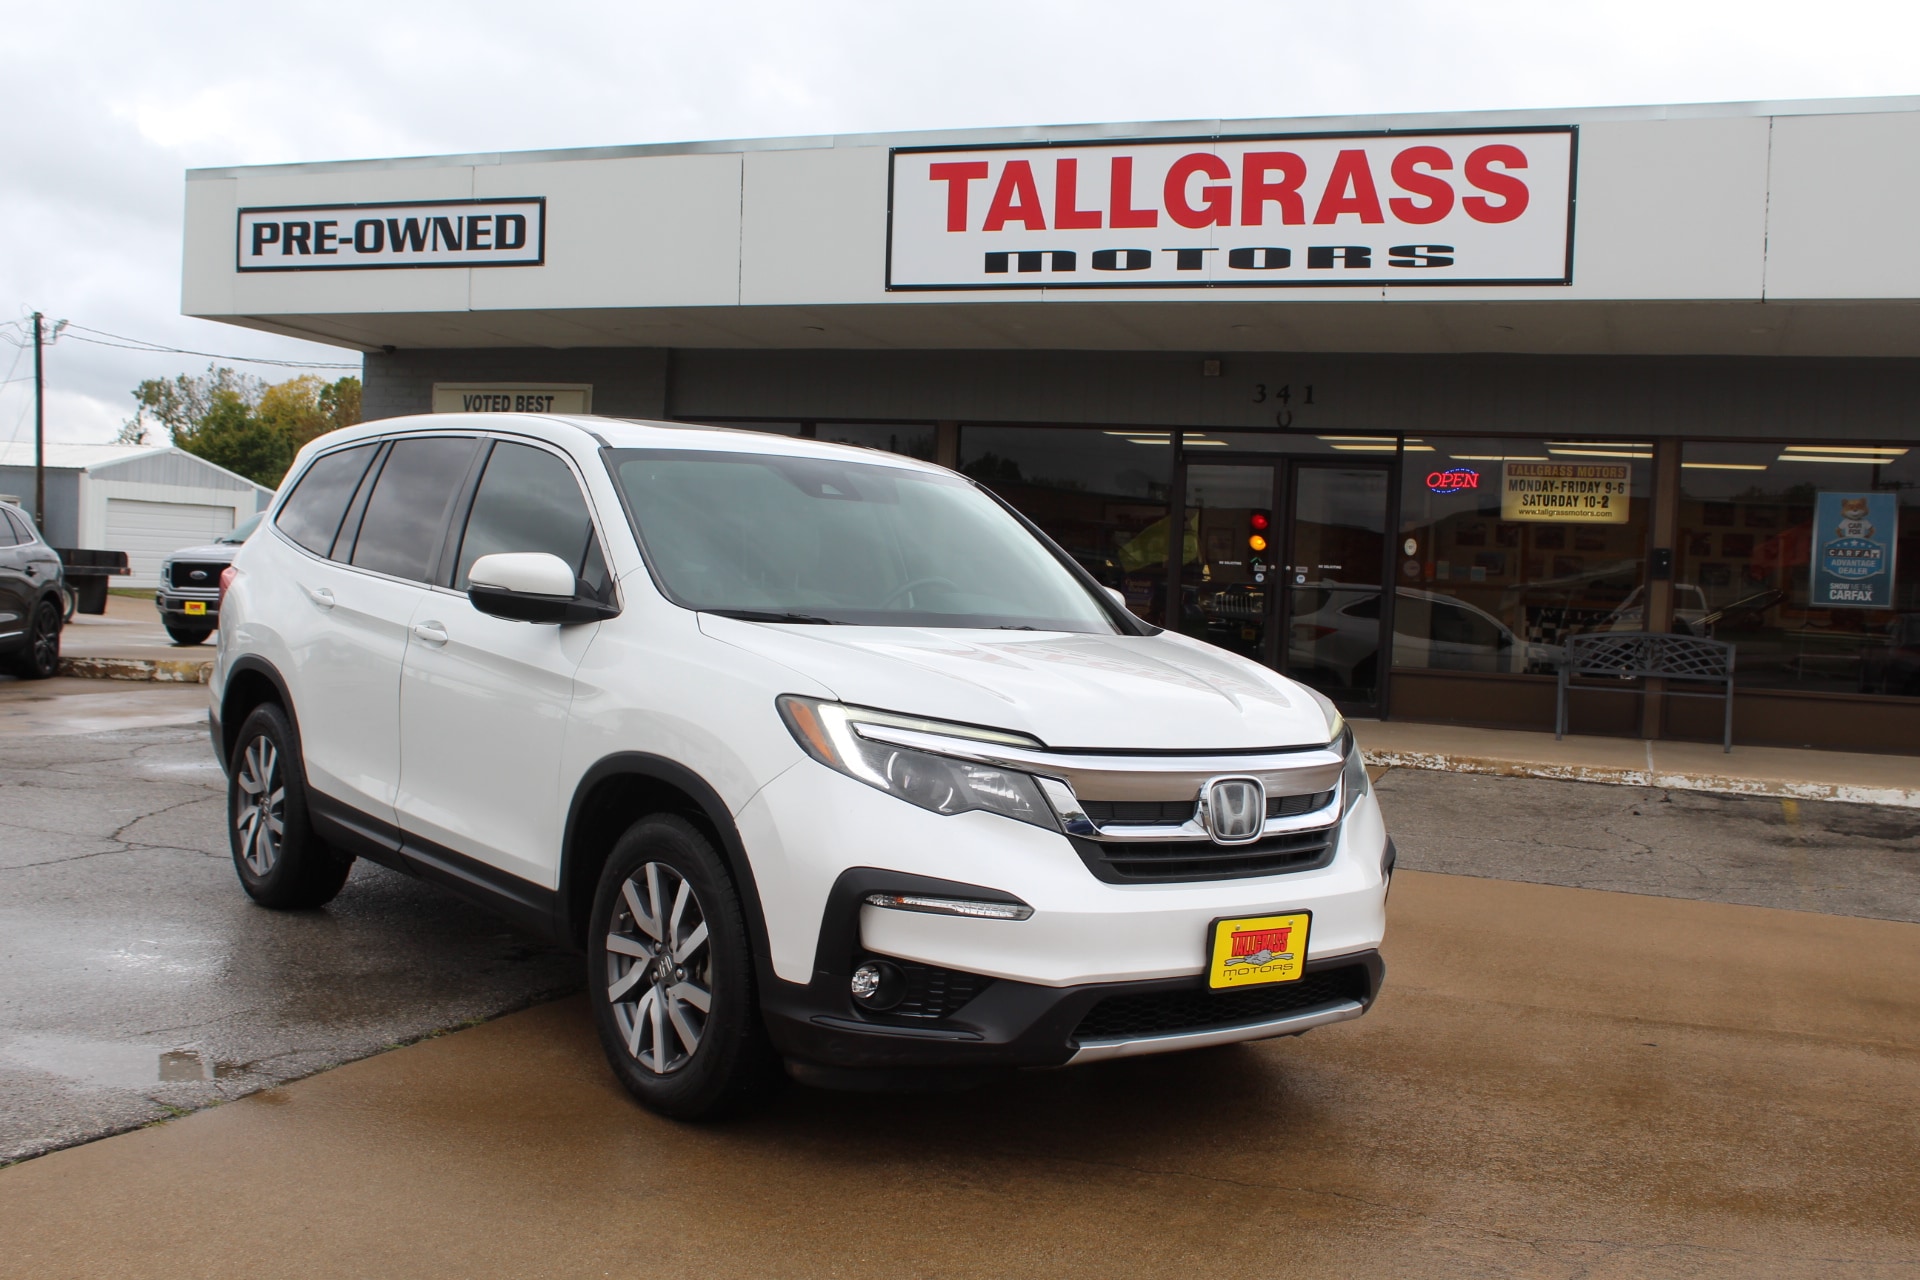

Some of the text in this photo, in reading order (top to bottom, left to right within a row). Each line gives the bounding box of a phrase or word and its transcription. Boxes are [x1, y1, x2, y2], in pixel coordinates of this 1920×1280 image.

[929, 144, 1530, 232] TALLGRASS
[252, 214, 526, 255] PRE-OWNED
[985, 244, 1454, 274] MOTORS
[463, 394, 554, 412] VOTED BEST
[1253, 383, 1315, 407] 341
[1510, 464, 1625, 478] TALLGRASS MOTORS
[1426, 471, 1479, 488] OPEN
[1508, 479, 1625, 494] MONDAY-FRIDAY 9-6
[1522, 494, 1609, 508] SATURDAY 10-2
[1518, 508, 1612, 518] www.tallgrassmotors.com
[1831, 559, 1876, 568] ADVANTAGE
[1829, 590, 1873, 601] CARFAX
[1231, 927, 1292, 957] TALLGRASS
[1223, 963, 1294, 977] MOTORS
